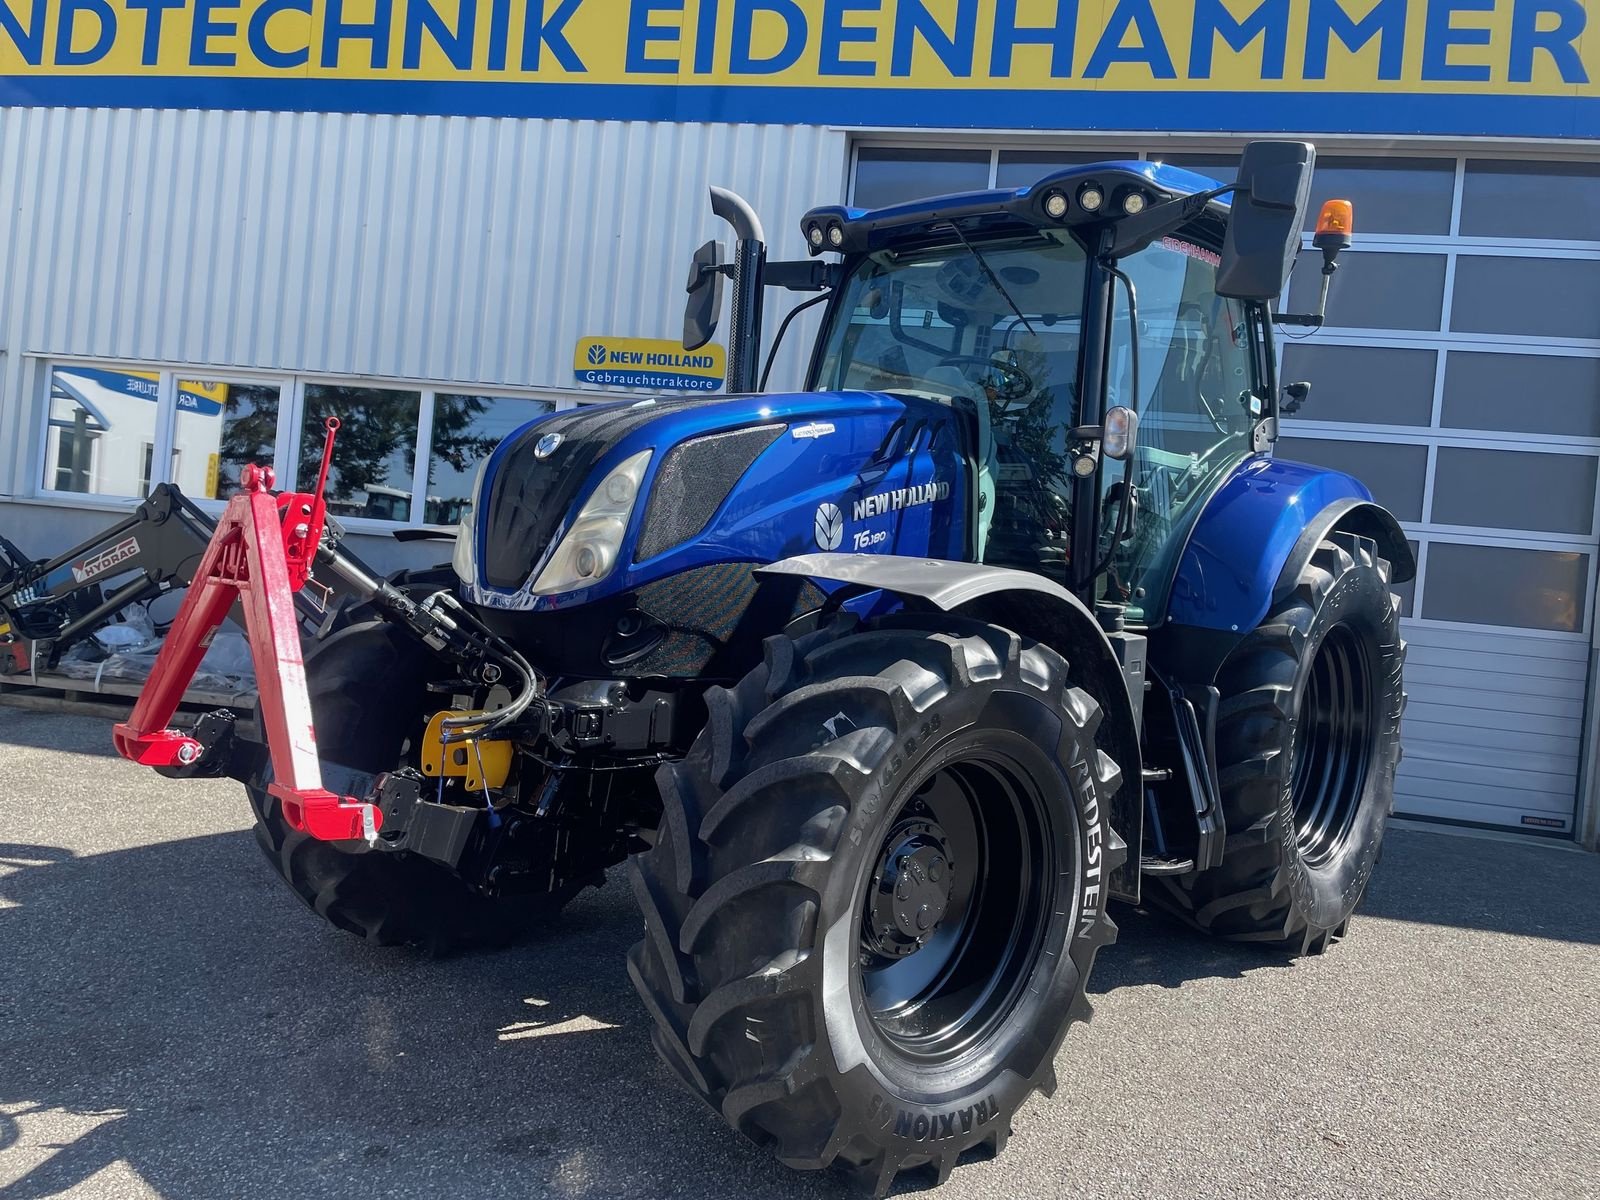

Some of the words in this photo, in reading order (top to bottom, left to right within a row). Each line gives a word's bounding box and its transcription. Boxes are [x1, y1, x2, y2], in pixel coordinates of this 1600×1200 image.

[0, 0, 588, 72] NDTECHNIK
[625, 0, 1590, 84] EIDENHAMMER
[610, 351, 643, 364] NEW
[646, 353, 713, 368] HOLLAND
[586, 371, 713, 389] Gebrauchttraktore
[853, 492, 889, 521] NEW
[891, 481, 950, 510] HOLLAND
[853, 530, 886, 551] T6.180
[85, 545, 137, 577] HYDRAC
[893, 1094, 1000, 1142] TRAXION
